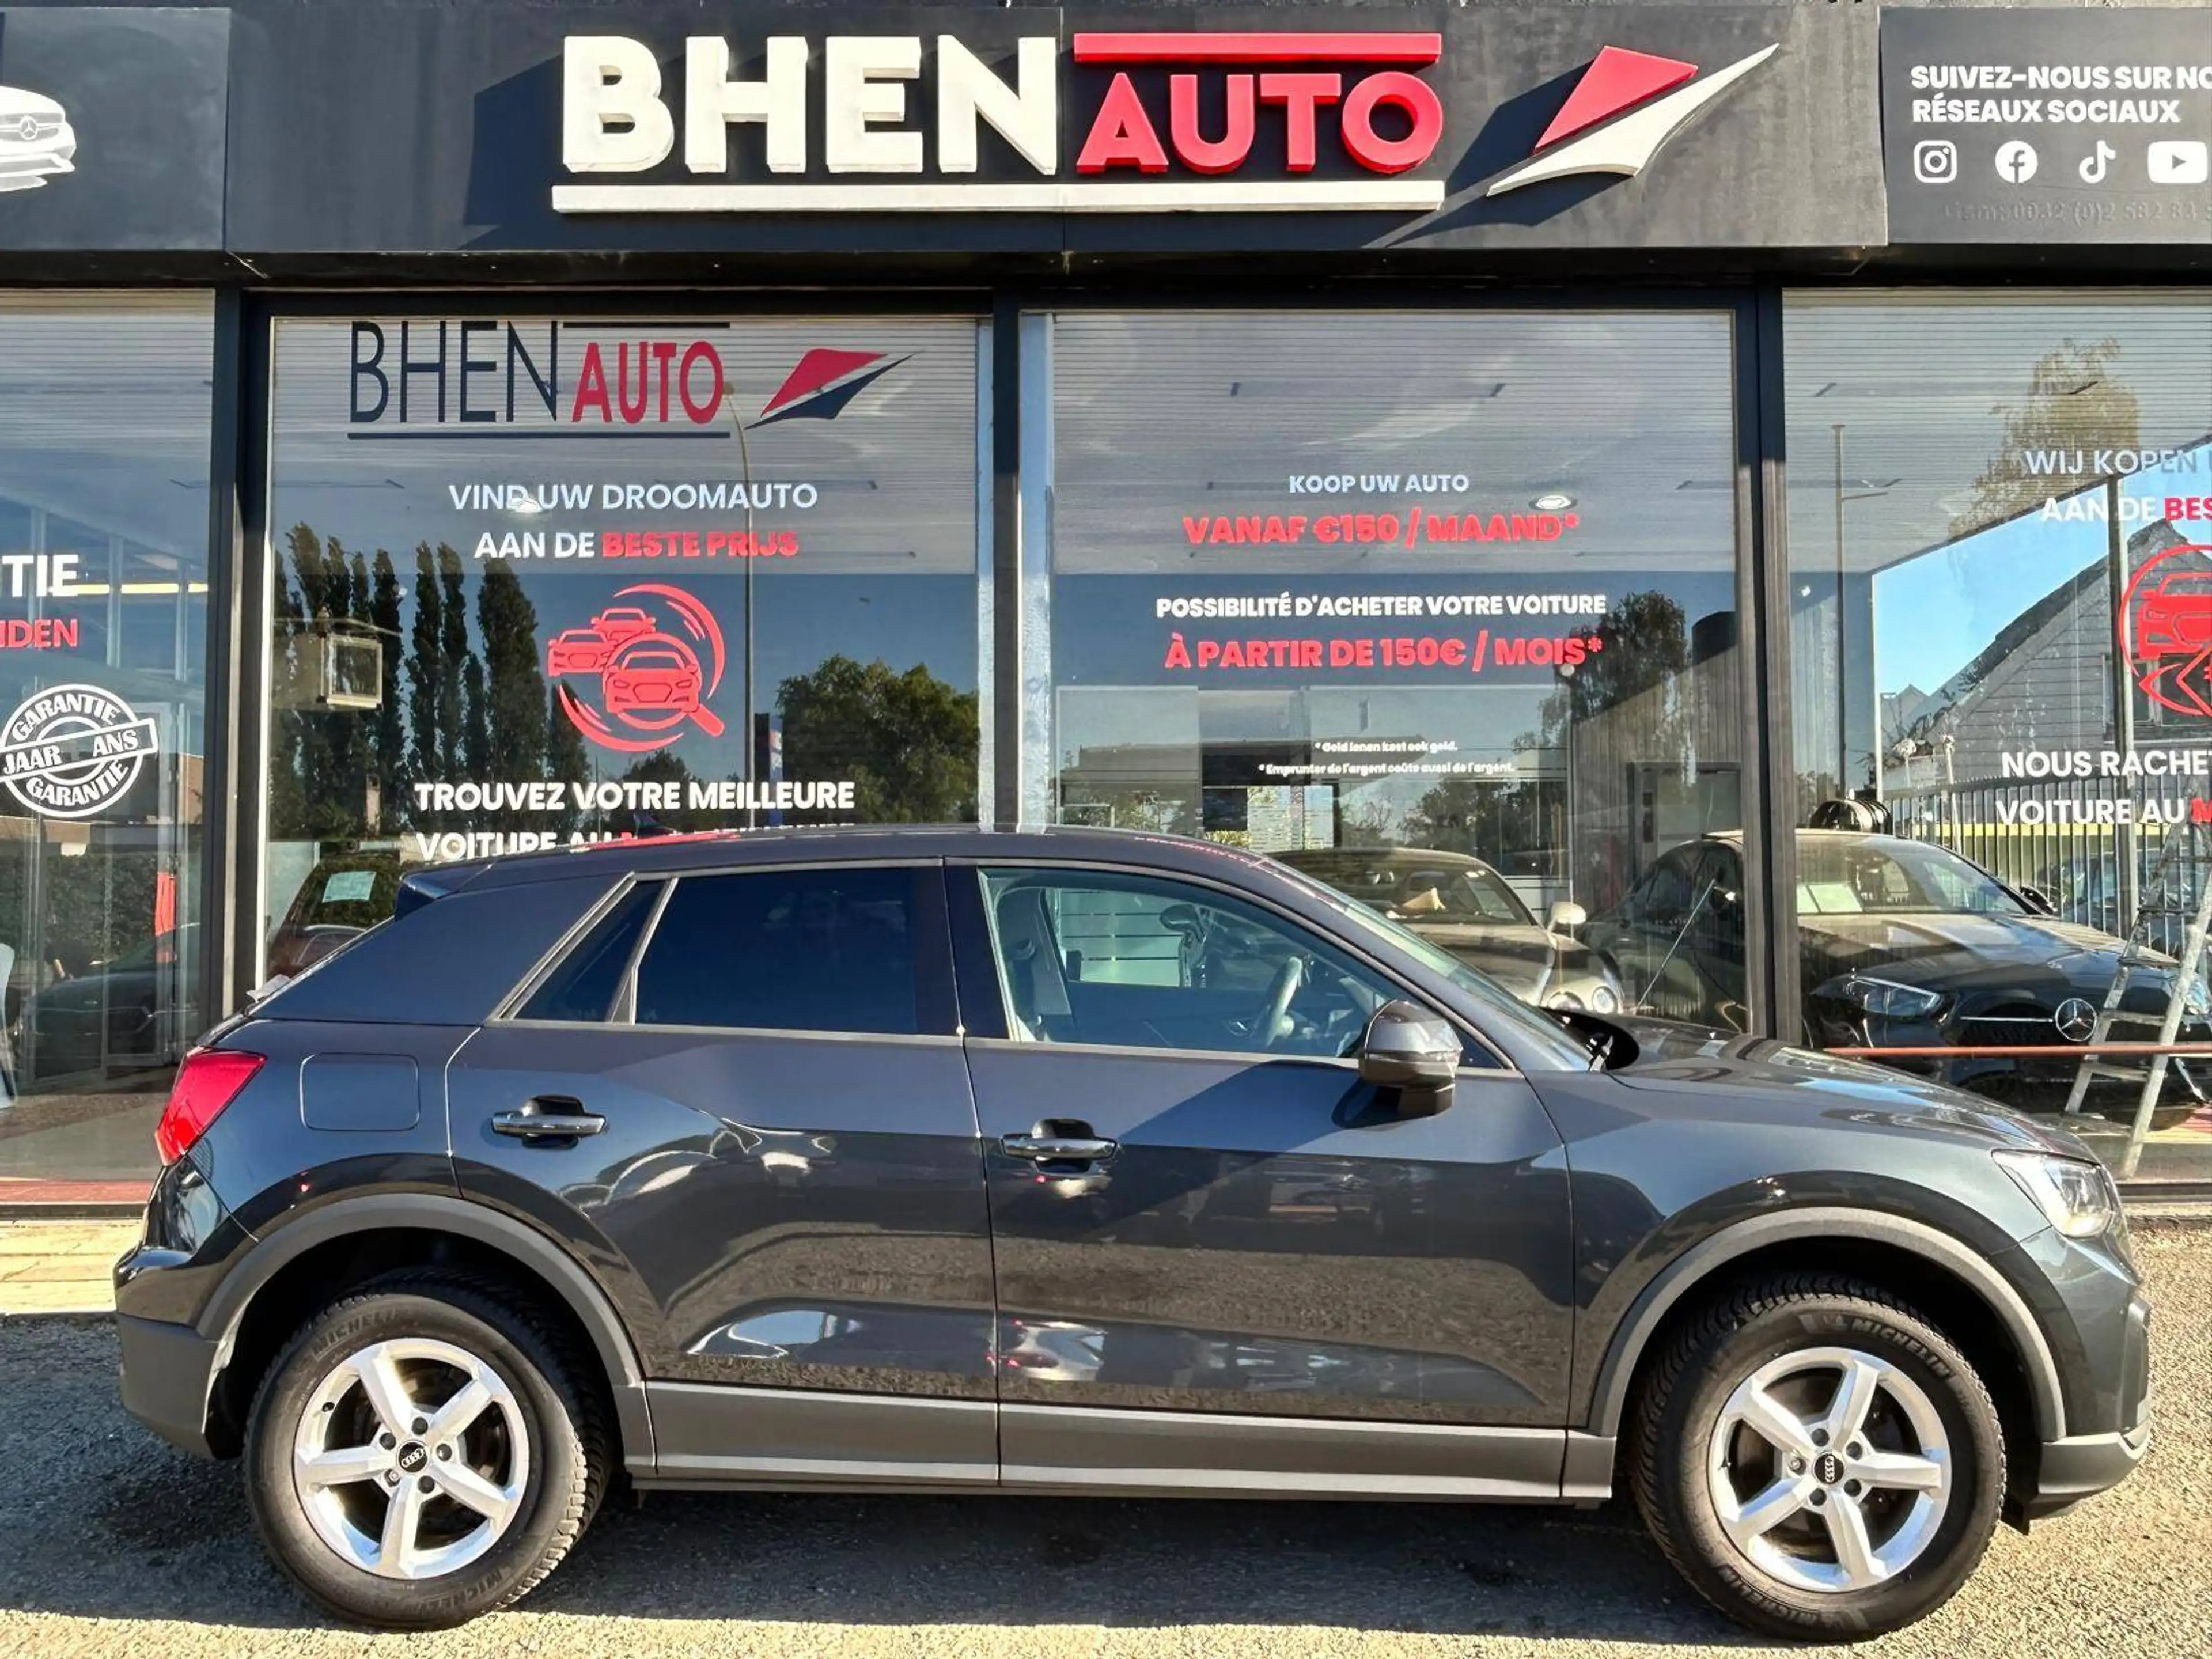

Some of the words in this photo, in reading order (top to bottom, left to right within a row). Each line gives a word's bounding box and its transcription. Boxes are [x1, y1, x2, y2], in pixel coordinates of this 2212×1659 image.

[1911, 66, 2109, 89] SUIVEZ-NOUS
[2115, 66, 2171, 89] SUR
[563, 35, 1057, 175] BHEN
[1076, 71, 1443, 175] AUTO
[1912, 93, 2043, 122] RÉSEAUX
[2048, 100, 2181, 122] SOCIAUX
[350, 320, 557, 423] BHEN
[571, 340, 724, 424] AUTO
[2025, 450, 2082, 474] WIJ
[2094, 450, 2197, 474] KOPEN
[449, 485, 529, 510] VIND
[538, 485, 592, 510] UW
[603, 485, 817, 510] DROOMAUTO
[1289, 475, 1355, 493] KOOP
[1360, 475, 1400, 493] UW
[1405, 474, 1469, 493] AUTO
[2041, 497, 2107, 521] AAN
[2119, 497, 2156, 521] DE
[1183, 516, 1307, 544] VANAF
[1313, 514, 1400, 543] €150
[474, 532, 550, 559] AAN
[555, 533, 595, 559] DE
[603, 532, 703, 558] BESTE
[708, 532, 799, 558] PRIJS
[1157, 591, 1290, 618] POSSIBILITÉ
[1296, 595, 1423, 616] D'ACHETER
[1426, 596, 1503, 616] VOTRE
[1506, 595, 1607, 615] VOITURE
[0, 619, 78, 648] DEN
[1165, 632, 1191, 669] À
[1198, 639, 1322, 668] PARTIR
[1331, 639, 1373, 667] DE
[1380, 638, 1465, 666] 150€
[12, 693, 120, 741] GARANTIE
[3, 745, 62, 774] JAAR
[93, 730, 138, 757] ANS
[2002, 751, 2092, 777] NOUS
[2101, 751, 2212, 776] RACHE
[26, 759, 128, 806] GARANTIE
[414, 782, 565, 810] TROUVEZ
[573, 782, 680, 809] VOTRE
[690, 782, 855, 809] MEILLEURE
[1995, 799, 2131, 824] VOITURE
[2139, 799, 2185, 824] AU
[1851, 1317, 1950, 1377] MICHELIN
